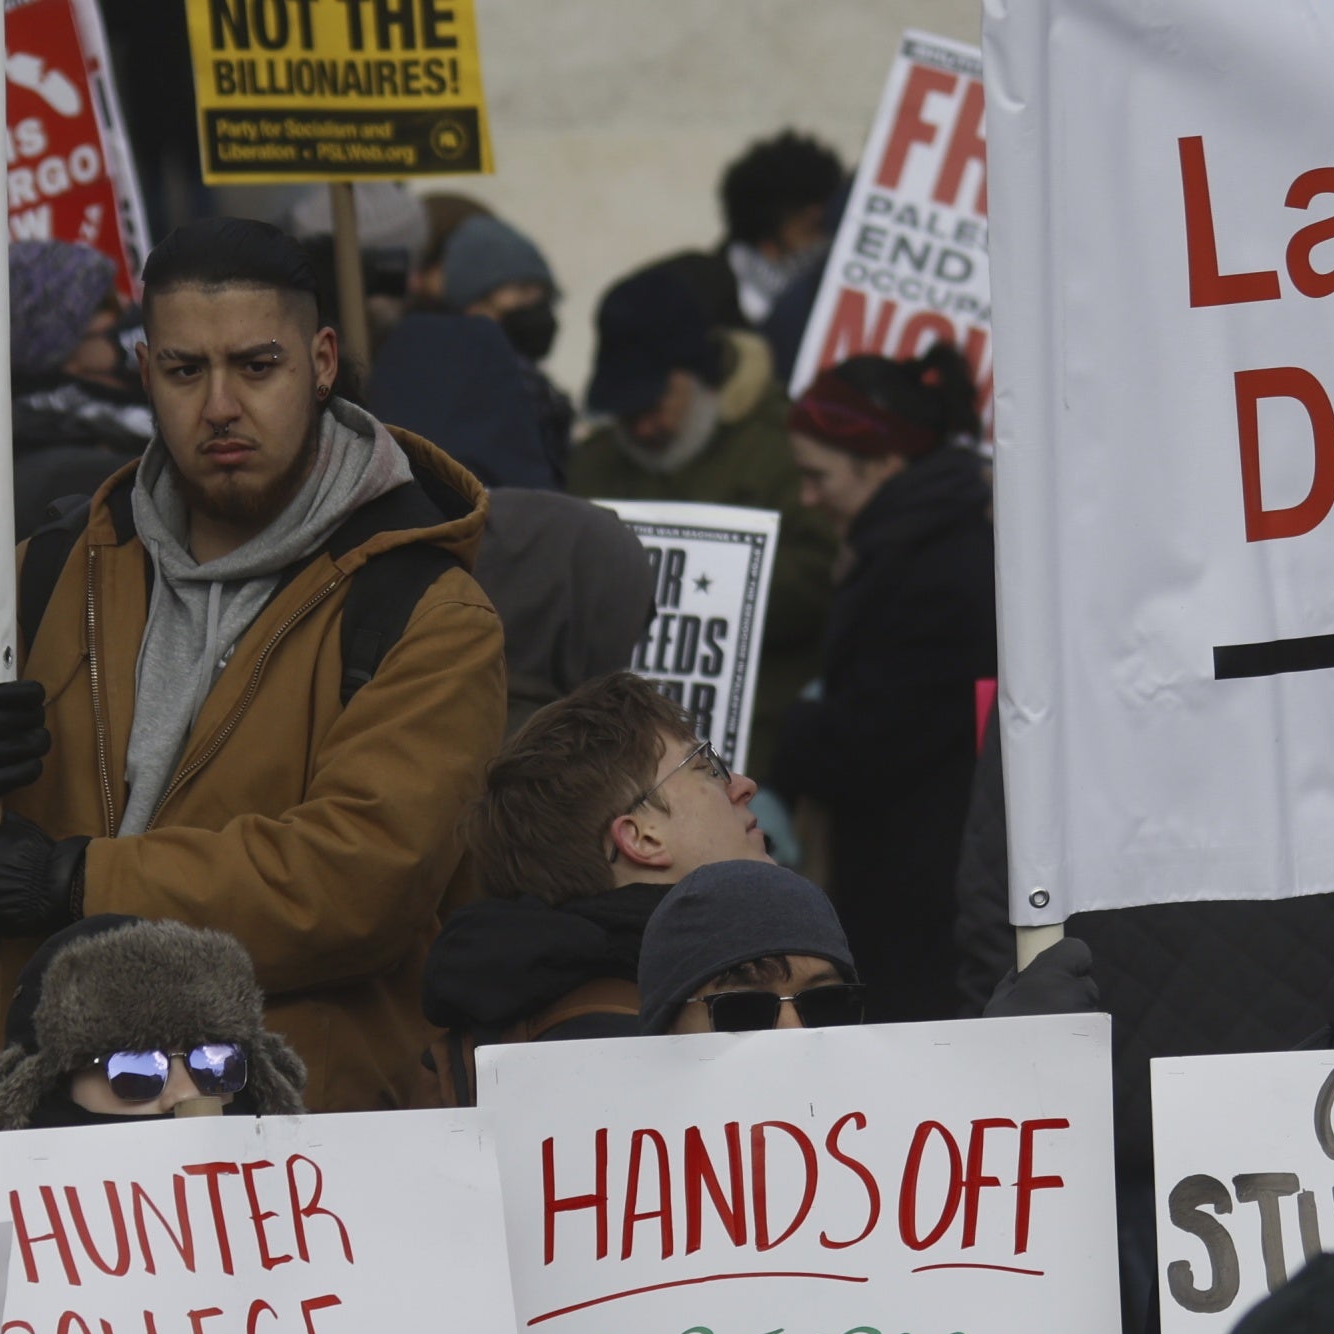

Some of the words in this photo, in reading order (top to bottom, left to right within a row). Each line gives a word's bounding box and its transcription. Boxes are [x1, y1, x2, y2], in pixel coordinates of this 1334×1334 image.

[209, 0, 315, 51] NOT
[337, 0, 459, 51] THE
[213, 57, 461, 98] BILLIONAIRES!
[866, 194, 987, 250] PALE
[854, 223, 974, 283] END
[656, 527, 680, 538] WAR
[541, 1111, 882, 1266] HANDS
[897, 1116, 1071, 1256] OFF
[8, 1153, 355, 1286] HUNTER
